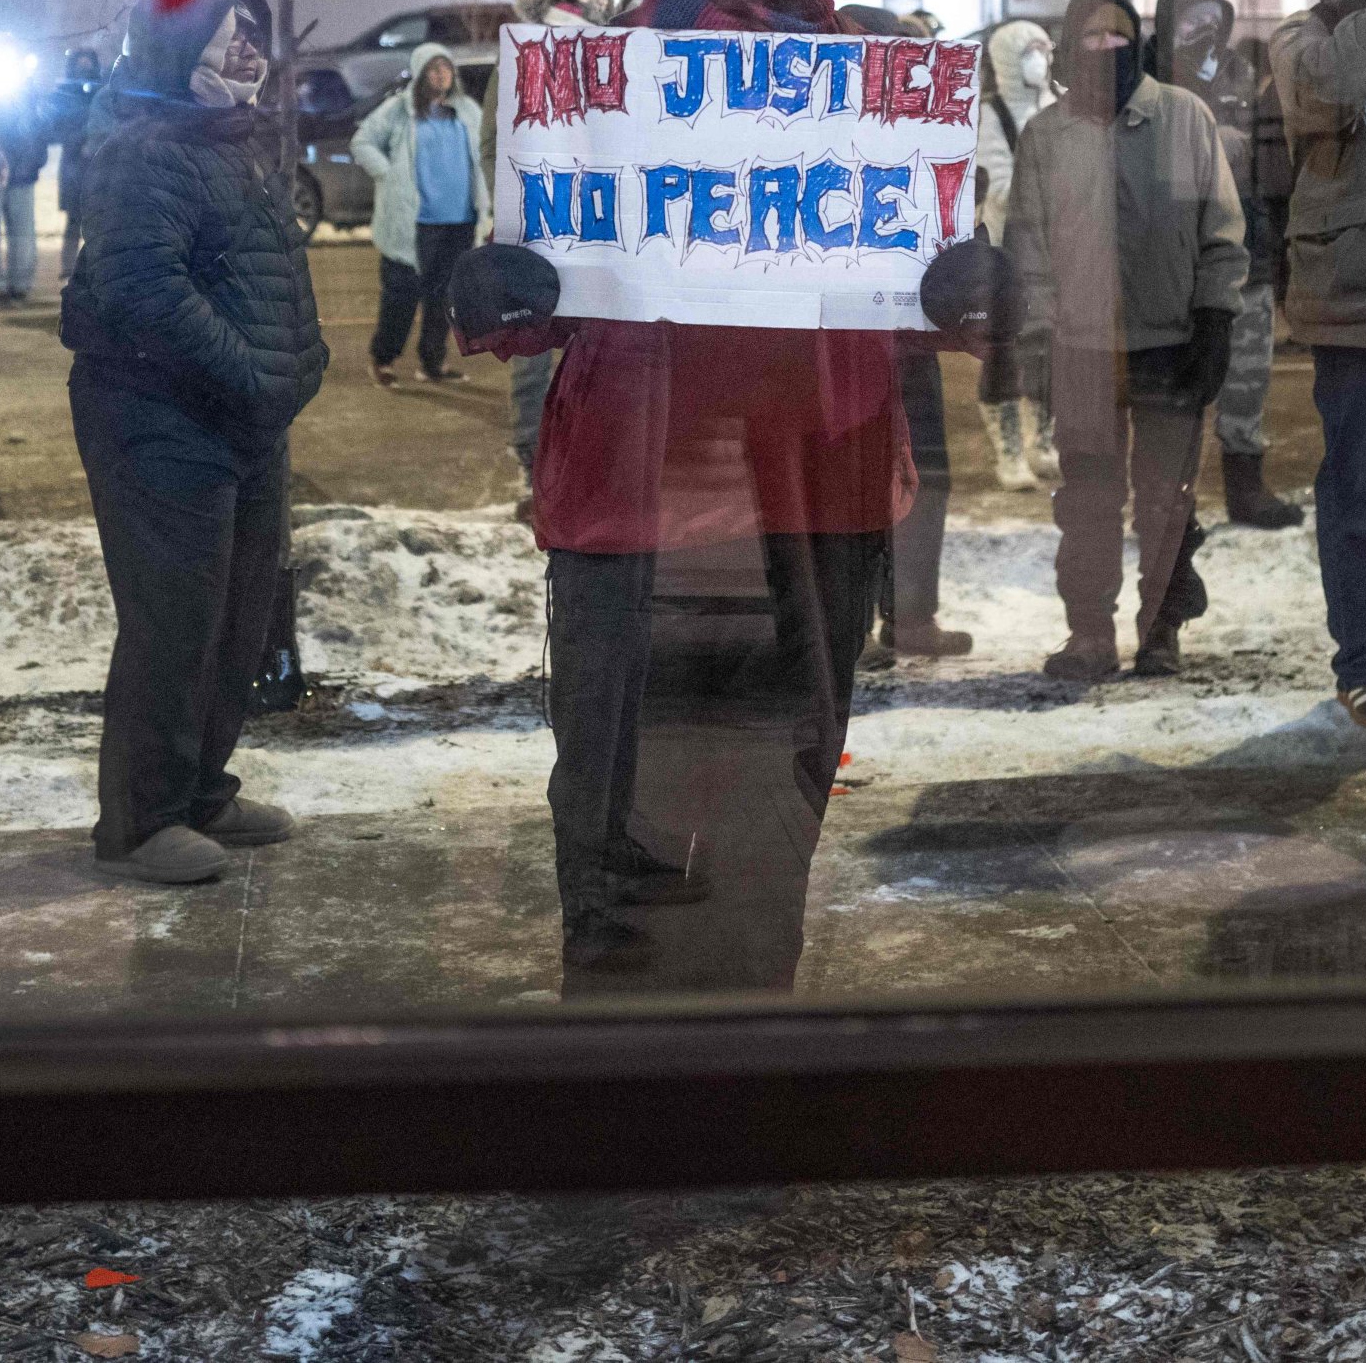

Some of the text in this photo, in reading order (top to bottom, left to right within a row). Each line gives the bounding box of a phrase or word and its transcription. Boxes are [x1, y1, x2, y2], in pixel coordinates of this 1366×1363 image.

[509, 28, 978, 130] NO JUSTICE
[510, 157, 625, 252] NO
